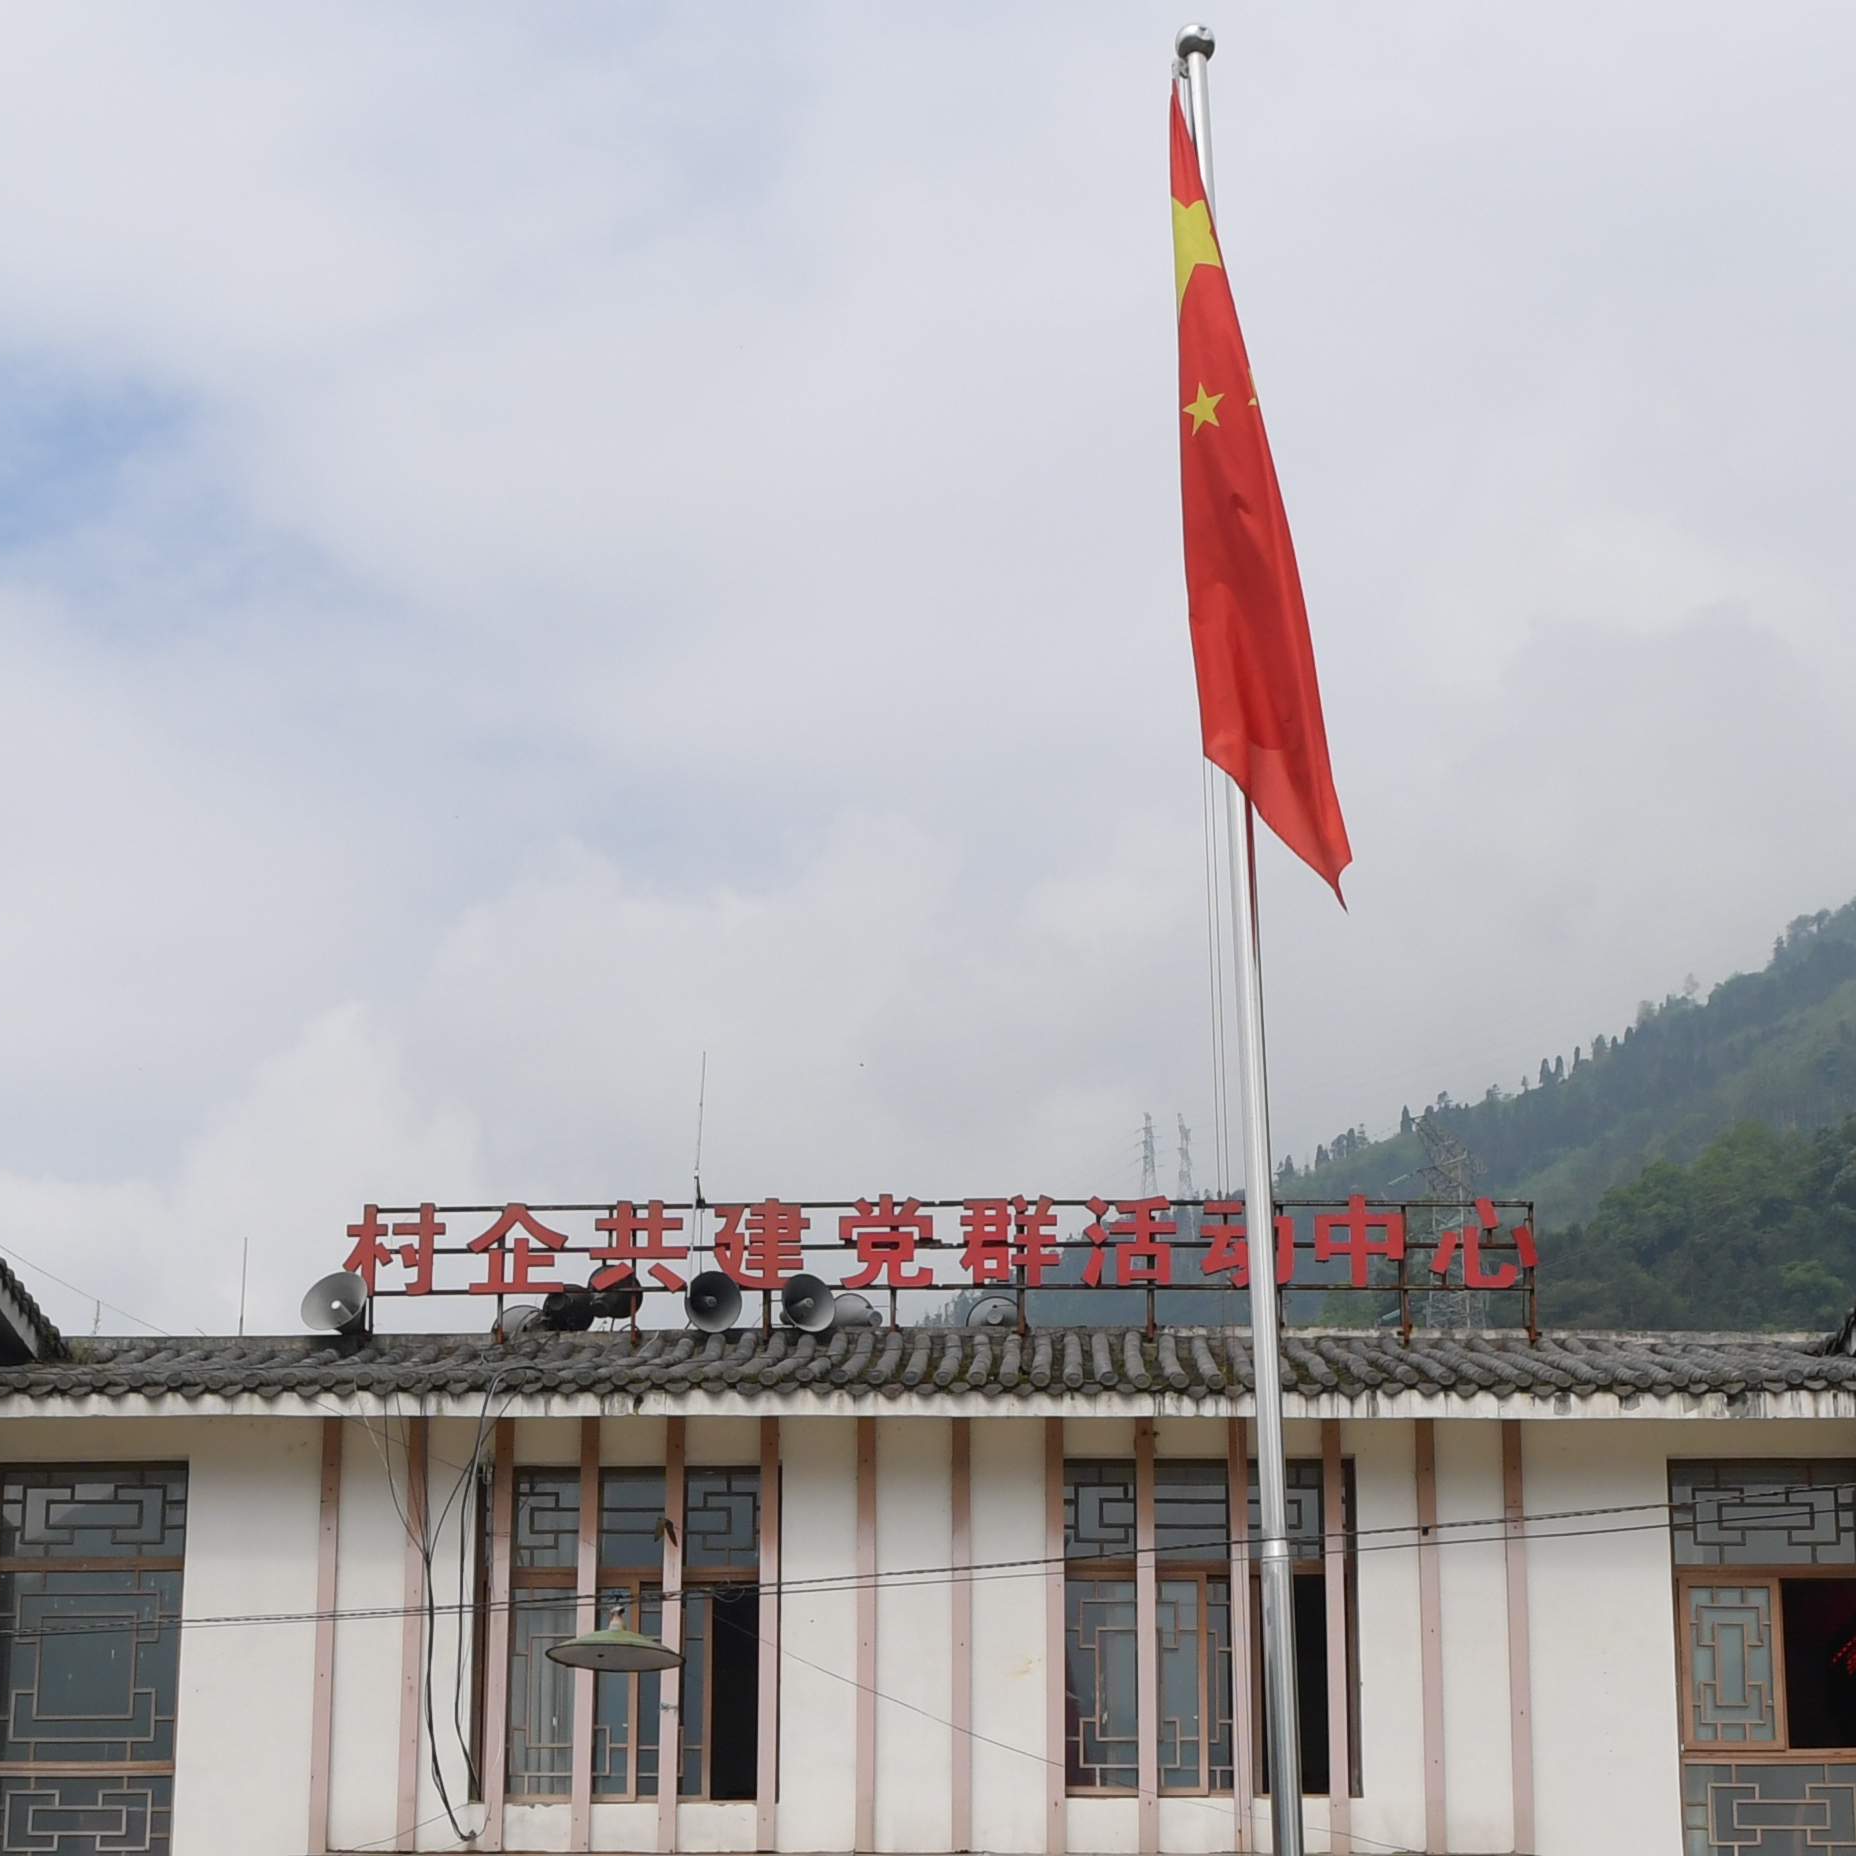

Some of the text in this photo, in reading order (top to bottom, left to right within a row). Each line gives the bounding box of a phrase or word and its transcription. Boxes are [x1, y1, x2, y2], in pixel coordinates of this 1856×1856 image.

[343, 1193, 1538, 1297] 村企共建党群活动中心
